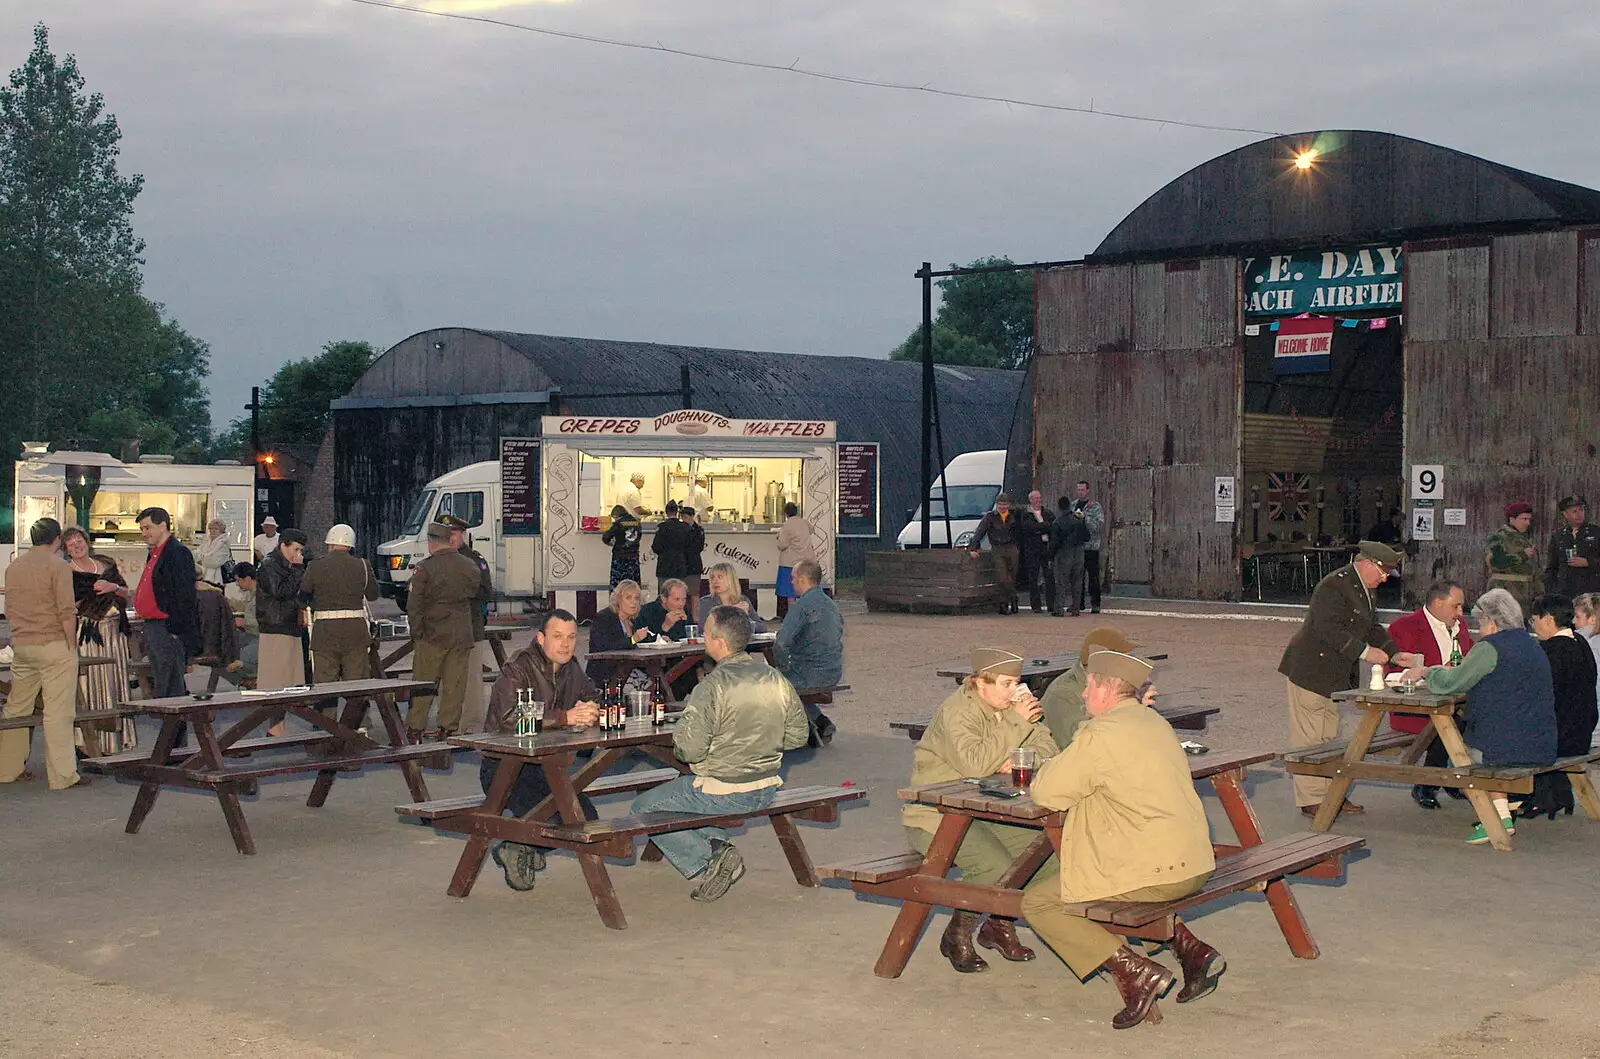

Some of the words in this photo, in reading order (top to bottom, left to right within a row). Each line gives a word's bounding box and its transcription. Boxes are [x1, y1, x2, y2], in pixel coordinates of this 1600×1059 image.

[1318, 247, 1402, 279] DAY
[1278, 338, 1308, 354] WELCOME
[1310, 336, 1330, 352] HOME
[559, 418, 641, 434] CREPES
[654, 411, 729, 431] DOUGHNUTS
[743, 422, 826, 437] WAFFLES
[1419, 470, 1436, 493] 9
[715, 541, 760, 569] Catering
